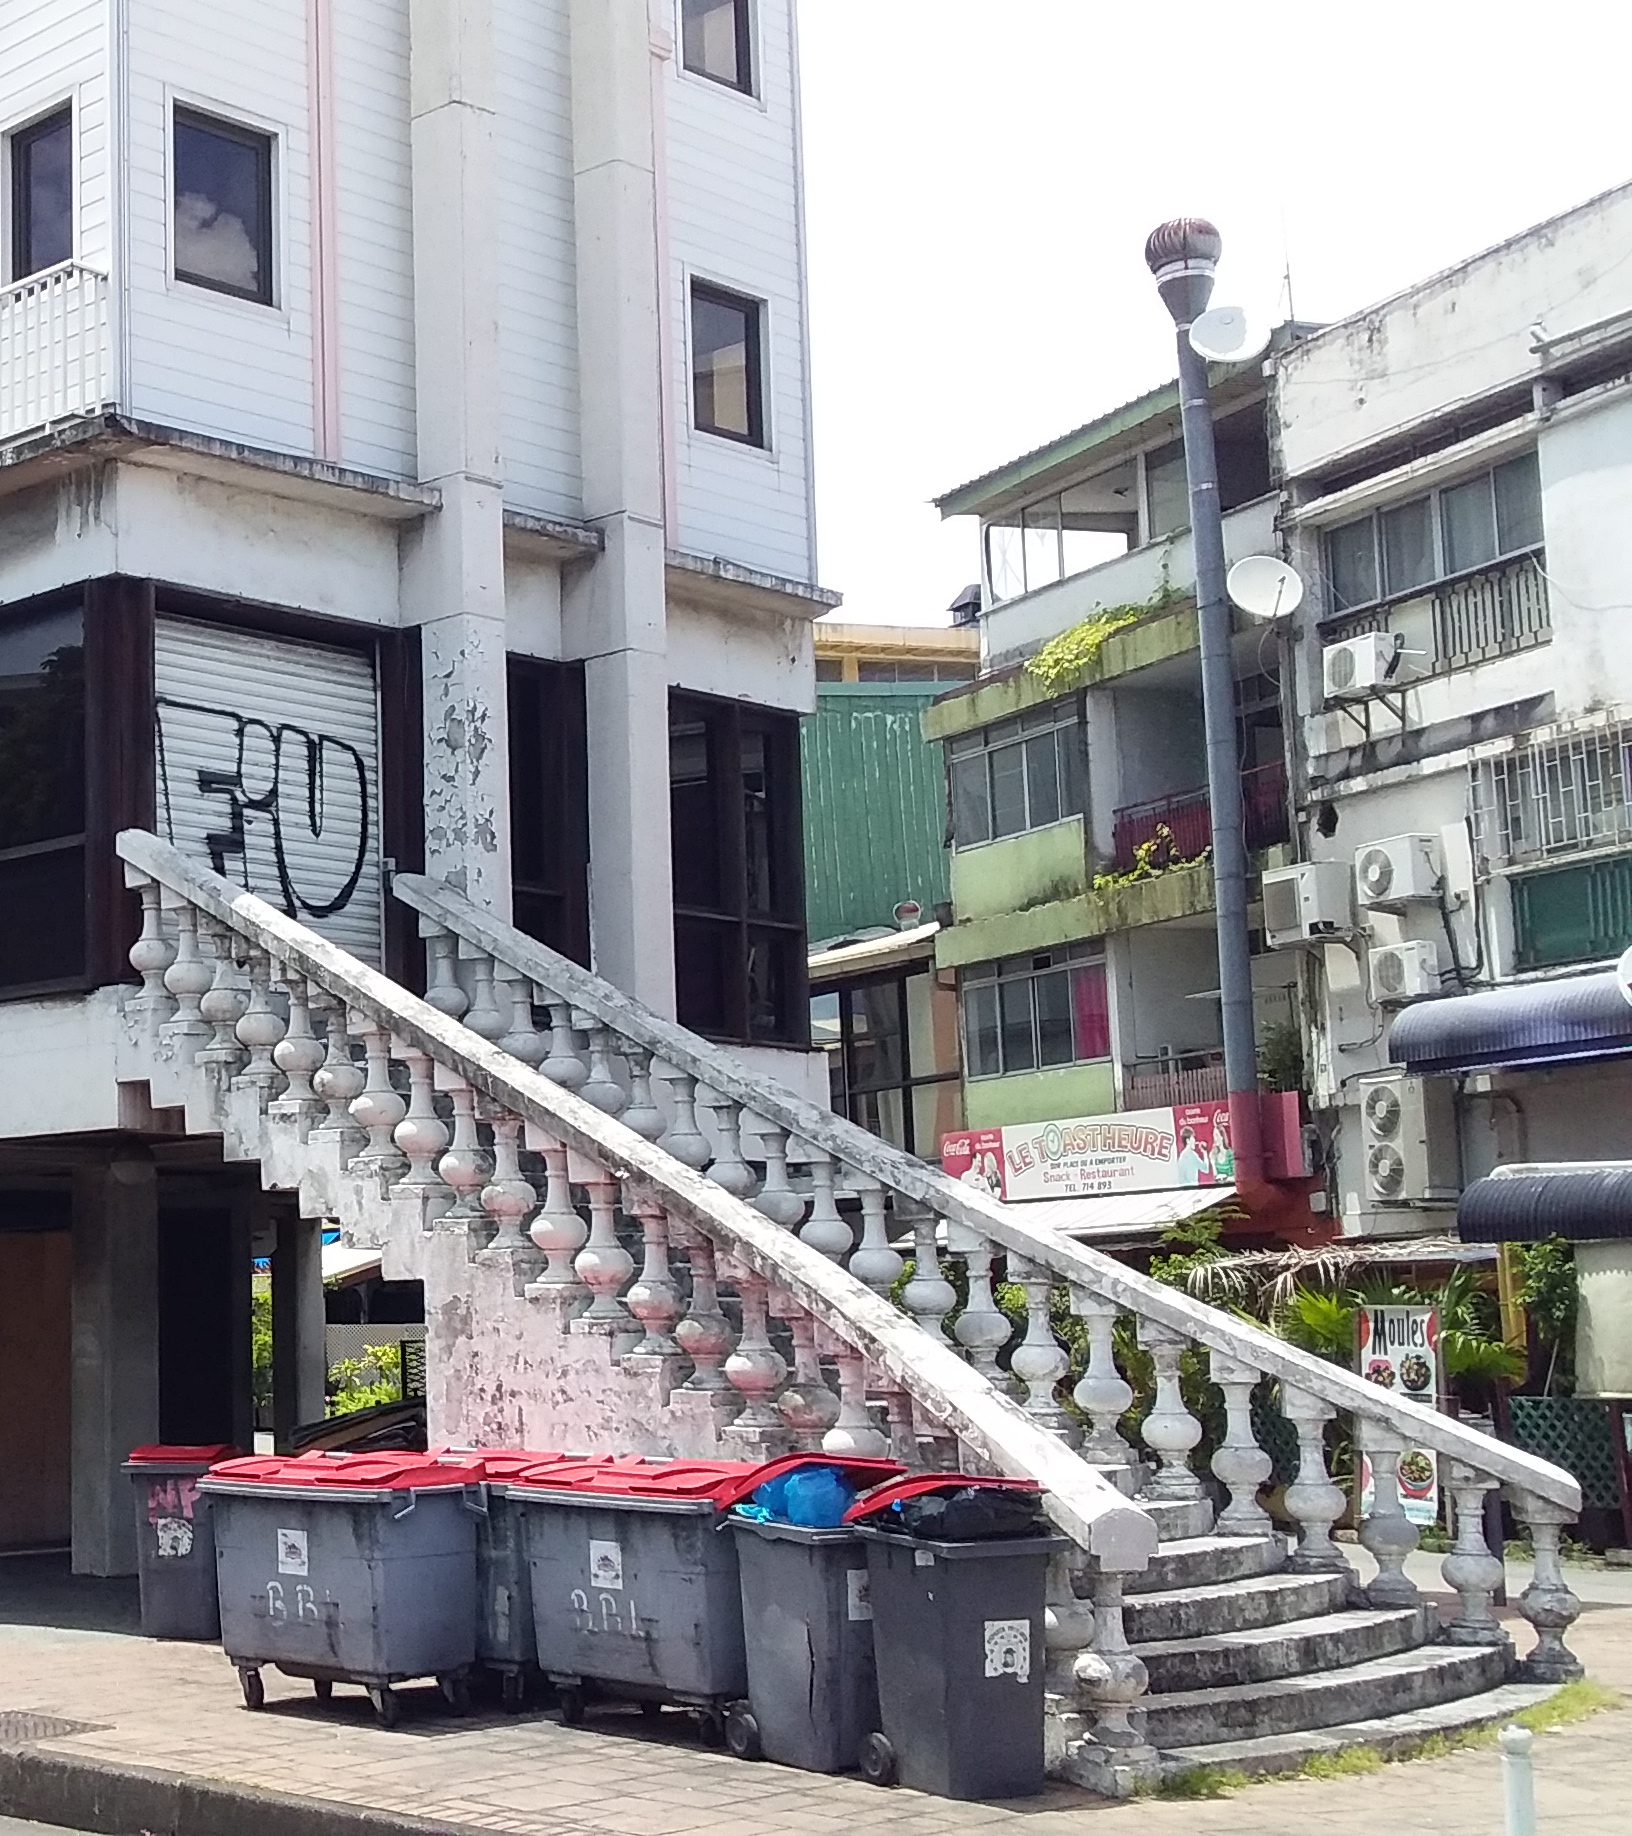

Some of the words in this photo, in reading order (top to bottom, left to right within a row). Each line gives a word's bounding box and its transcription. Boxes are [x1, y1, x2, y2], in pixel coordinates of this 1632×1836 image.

[1006, 1142, 1035, 1177] LE
[1063, 1160, 1079, 1168] PLACE
[1095, 1156, 1127, 1166] EMPORTER
[1043, 1171, 1071, 1183] Snack
[1080, 1166, 1135, 1181] Restaurant
[1082, 1181, 1095, 1192] 714
[1097, 1181, 1112, 1190] 893
[1371, 1309, 1426, 1356] Moules
